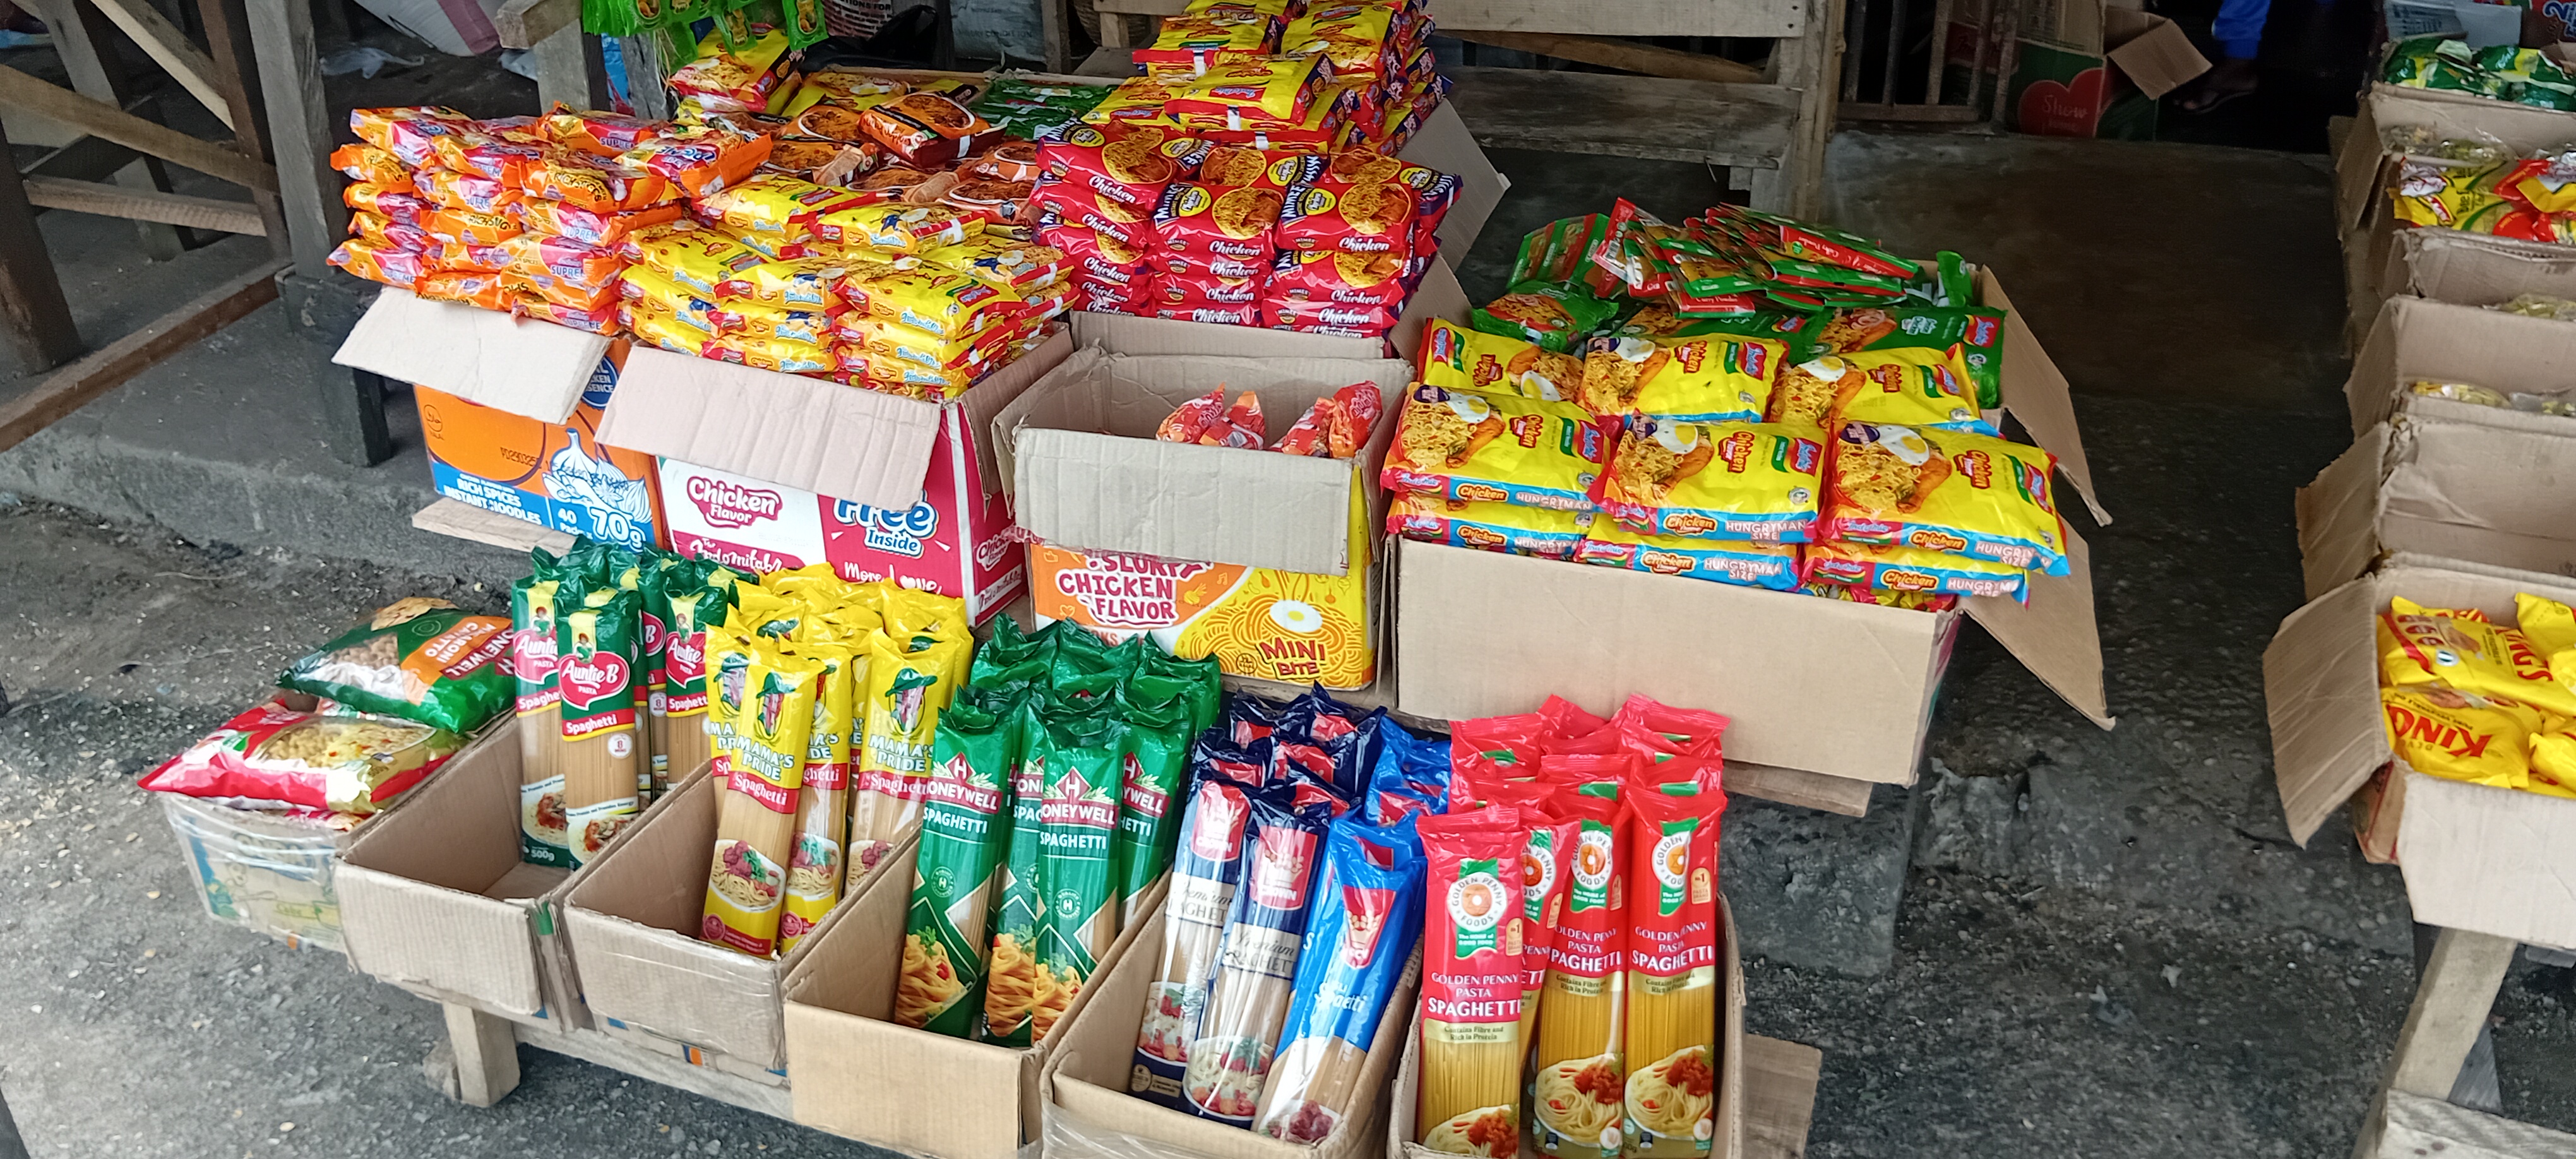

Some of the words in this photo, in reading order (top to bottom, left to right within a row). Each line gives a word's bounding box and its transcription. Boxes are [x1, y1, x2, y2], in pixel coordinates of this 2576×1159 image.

[601, 138, 633, 149] SUPRE
[1088, 175, 1136, 203] Chicken
[1082, 213, 1129, 242] Chicken
[1210, 241, 1260, 256] Chicken
[1339, 237, 1390, 252] Chicken
[551, 266, 584, 278] SUPRE
[1084, 258, 1130, 282] Chicken
[1206, 288, 1254, 302] Chicken
[1331, 290, 1381, 304] Chicken
[1192, 308, 1240, 324] Chicken
[1319, 308, 1369, 324] Chicken
[457, 479, 482, 495] RICH
[486, 487, 522, 507] SPICES
[688, 477, 778, 516] Chicken
[1458, 485, 1506, 501] Chicken
[1517, 492, 1592, 511] HUNGRYMAN
[444, 485, 487, 509] INSTANT
[490, 501, 542, 526] NOODLES
[558, 508, 576, 523] 40
[710, 504, 753, 524] Flavor
[589, 507, 645, 554] 70g
[1666, 514, 1716, 532] Chicken
[1725, 520, 1807, 533] HUNGRYMAN
[868, 529, 919, 553] Inside
[1460, 526, 1505, 542] Chicken
[1515, 538, 1577, 552] HUNGRY
[1751, 530, 1779, 540] SIZE
[1911, 532, 1965, 551] Chicken
[1642, 552, 1695, 570] Chicken
[1059, 569, 1174, 600] CHICKEN
[1729, 569, 1756, 581] SIZE
[1883, 571, 1938, 588] Chicken
[1096, 597, 1176, 621] FLAVOR
[445, 627, 514, 677] ONEYWELL
[667, 641, 701, 662] Auntie
[1260, 636, 1326, 663] MINI
[534, 660, 554, 668] PASTA
[562, 663, 605, 684] Auntie
[605, 662, 618, 683] B
[1277, 661, 1320, 676] BITE
[518, 691, 559, 710] Spaghe
[578, 686, 597, 695] PASTA
[566, 714, 617, 734] Spaghetti
[736, 735, 795, 768] MAMA'S
[742, 753, 782, 782] PRIDE
[876, 752, 926, 773] PRIDE
[804, 765, 840, 783] ghetti
[734, 773, 788, 807] Spaghetti
[927, 782, 998, 812] ONEYWELL
[1122, 788, 1164, 814] YWELL
[923, 805, 988, 835] SPAGHETTI
[1041, 804, 1116, 825] ONEYWELL
[1121, 817, 1152, 837] HETTI
[1040, 831, 1107, 850] SPAGHETTI
[530, 850, 555, 862] 500g
[1577, 871, 1606, 885] FOODS
[1452, 877, 1478, 906] GOLDEN
[1482, 877, 1502, 906] PENNY
[1460, 915, 1494, 927] FOODS
[1635, 925, 1680, 942] GOLDEN
[1568, 941, 1602, 954] PASTA
[1551, 949, 1621, 972] PAGHETTI
[1631, 944, 1714, 972] SPAGHETTI
[1431, 972, 1479, 985] GOLDEN
[1482, 973, 1518, 985] PENNY
[1455, 987, 1493, 998] PASTA
[1428, 997, 1521, 1017] SPAGHETTI
